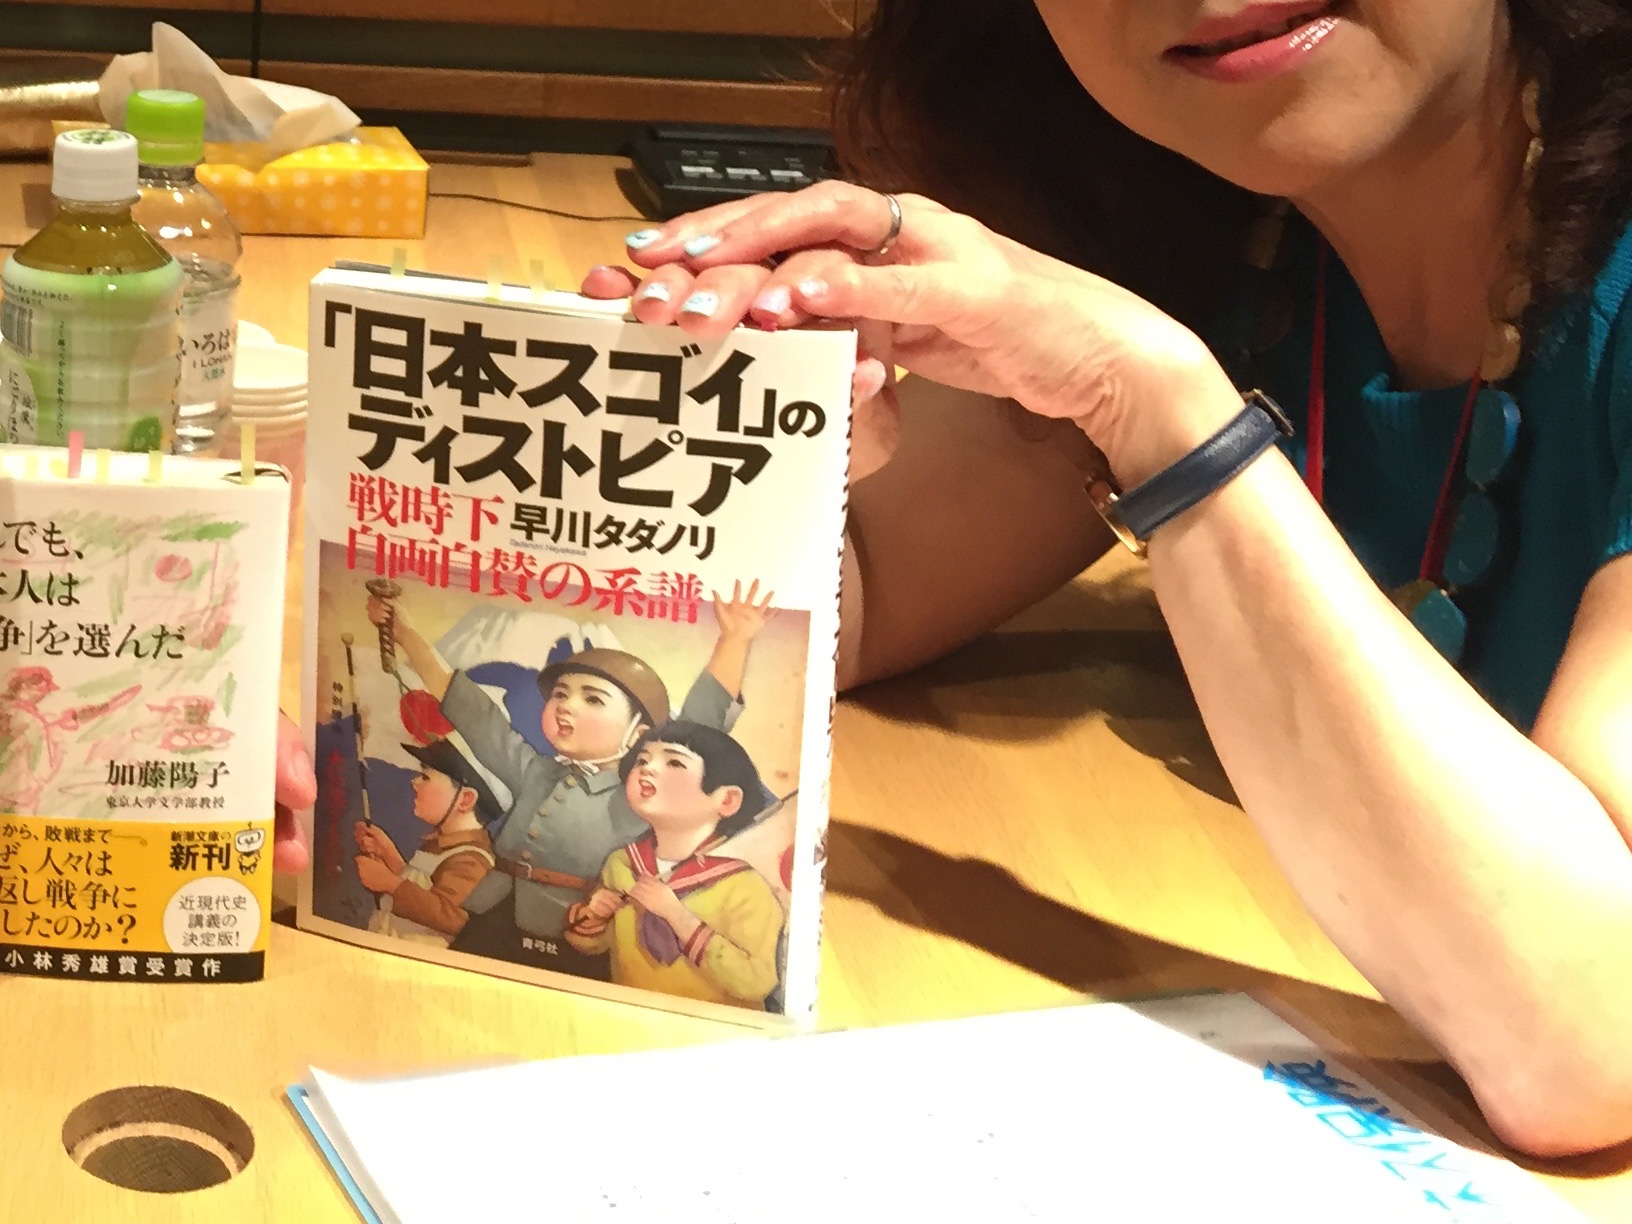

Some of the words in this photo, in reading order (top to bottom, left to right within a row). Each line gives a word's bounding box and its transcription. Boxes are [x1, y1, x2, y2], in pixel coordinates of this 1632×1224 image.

[324, 300, 827, 438] 「日本スゴイ」の
[347, 393, 773, 517] ディストピア
[347, 472, 505, 542] 戦時下
[510, 501, 716, 560] 早川タダノリ
[346, 524, 705, 624] 自画自賛の系譜
[105, 760, 231, 789] 加藤陽子
[169, 842, 232, 871] 新刊
[179, 894, 248, 911] 近現代史
[187, 913, 238, 929] 講義の
[4, 949, 222, 977] 小林秀雄賞受賞作
